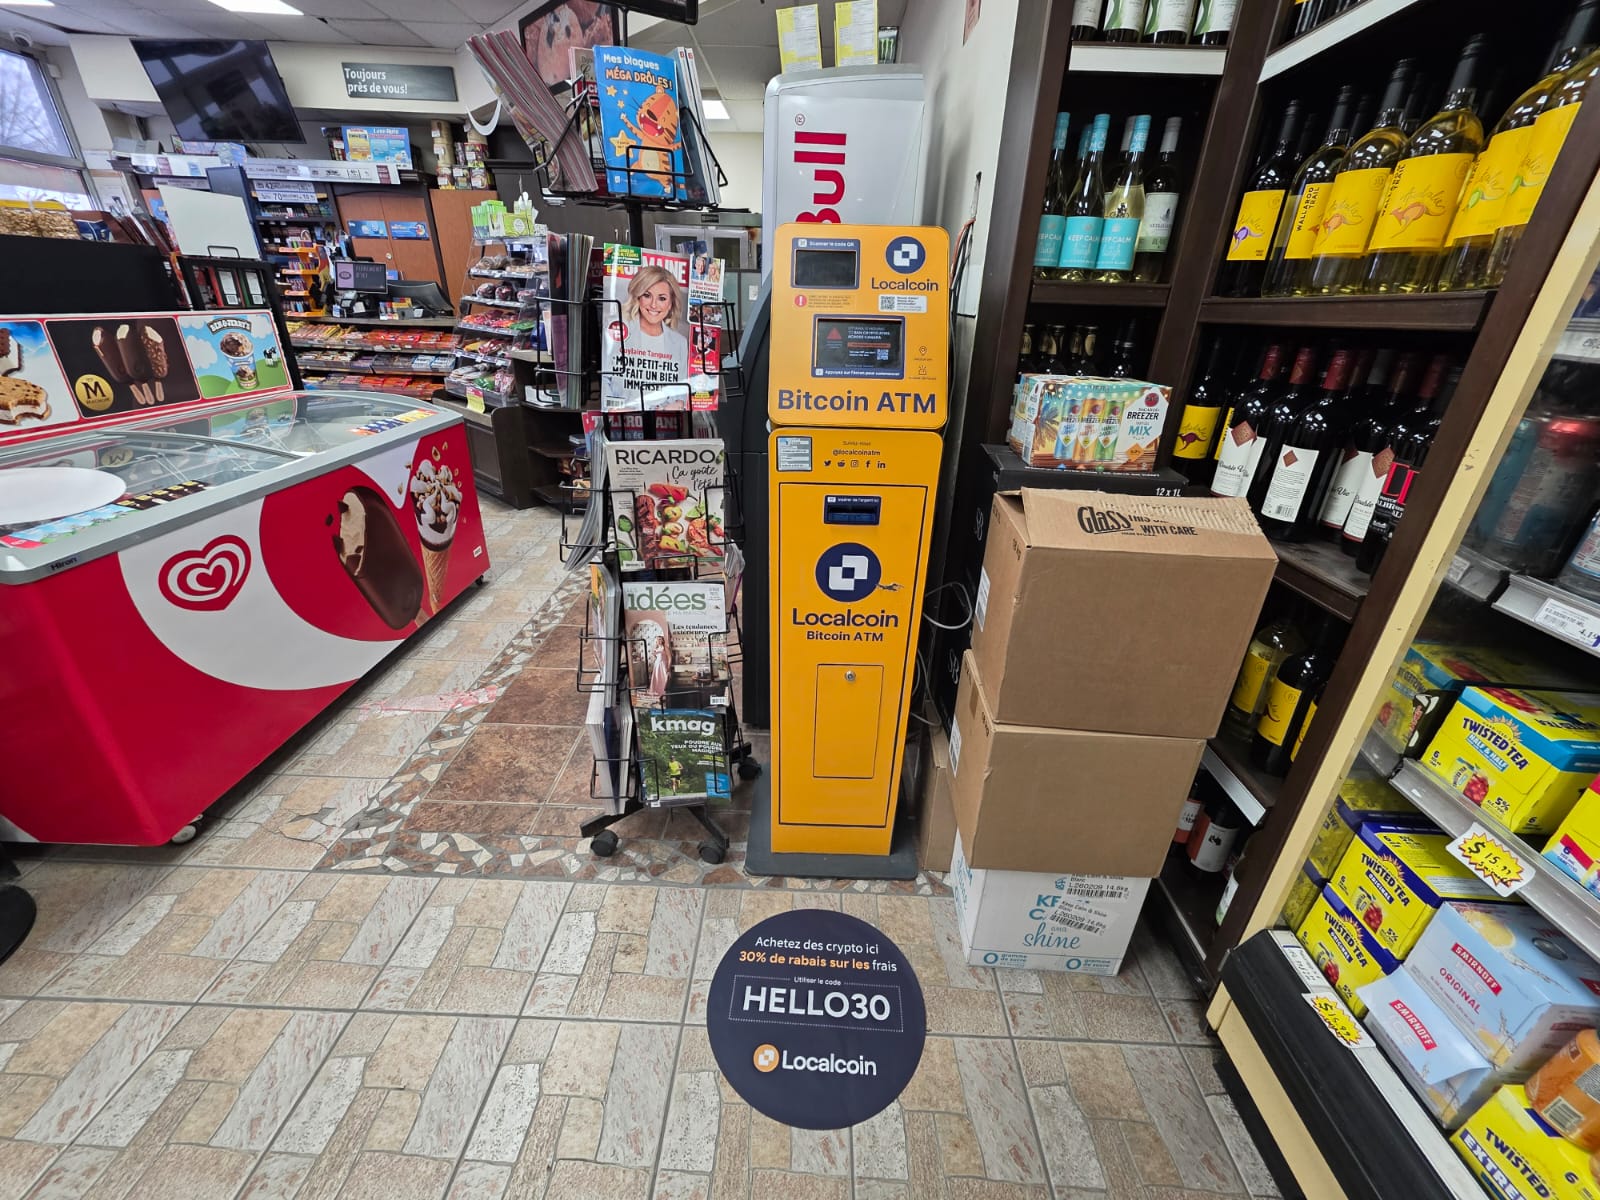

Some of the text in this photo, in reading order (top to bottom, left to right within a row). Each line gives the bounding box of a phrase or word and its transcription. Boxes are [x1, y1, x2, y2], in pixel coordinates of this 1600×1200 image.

[604, 54, 660, 70] Mes blagues
[344, 68, 386, 81] Toujours
[606, 66, 632, 80] MÉGA
[348, 82, 408, 94] près de vous!
[872, 277, 938, 291] Localcoin
[637, 358, 678, 372] PETIT-FILS
[626, 368, 642, 379] FAIT
[646, 370, 658, 380] UN
[660, 372, 678, 382] BIEN
[82, 382, 104, 400] M
[778, 390, 936, 414] Bitcoin ATM
[1126, 412, 1160, 420] BREEZER
[1128, 426, 1152, 436] MIX
[615, 449, 716, 465] RICARDO
[690, 465, 718, 480] goûte
[1156, 488, 1164, 496] 12
[1078, 506, 1131, 534] Glass
[1140, 525, 1198, 536] WITH CARE
[627, 586, 706, 610] idées
[792, 608, 899, 628] Localcoin
[806, 630, 884, 642] Bitcoin ATM
[651, 716, 716, 736] kmag
[1462, 718, 1529, 770] TWISTED TEA
[1469, 734, 1484, 748] HALF
[1490, 752, 1508, 768] HALF
[1434, 750, 1440, 758] 6
[1495, 797, 1510, 811] 5%
[1528, 816, 1537, 824] 6
[1468, 842, 1486, 854] $
[1564, 846, 1570, 854] 6
[1361, 853, 1410, 906] TWISTED TEA
[1368, 872, 1391, 900] ORIGINAL
[1023, 922, 1080, 950] shine
[1324, 912, 1368, 968] TWISTED TEA
[1387, 928, 1398, 941] 5%
[755, 936, 878, 954] Achetez des crypto ici
[1330, 931, 1350, 960] ORIGINAL
[739, 950, 897, 972] 30% de rabais sur les frais
[1455, 946, 1499, 989] SMIRNOFF
[794, 976, 816, 984] Utiliser
[824, 978, 842, 986] code
[1440, 968, 1481, 1015] ORIGINAL
[742, 985, 891, 1021] HELLO30
[1320, 1002, 1332, 1012] $
[1394, 1002, 1434, 1047] SMIRNOFF
[782, 1050, 877, 1076] Localcoin
[1485, 1127, 1550, 1198] TWISTED
[1564, 1172, 1580, 1184] 6
